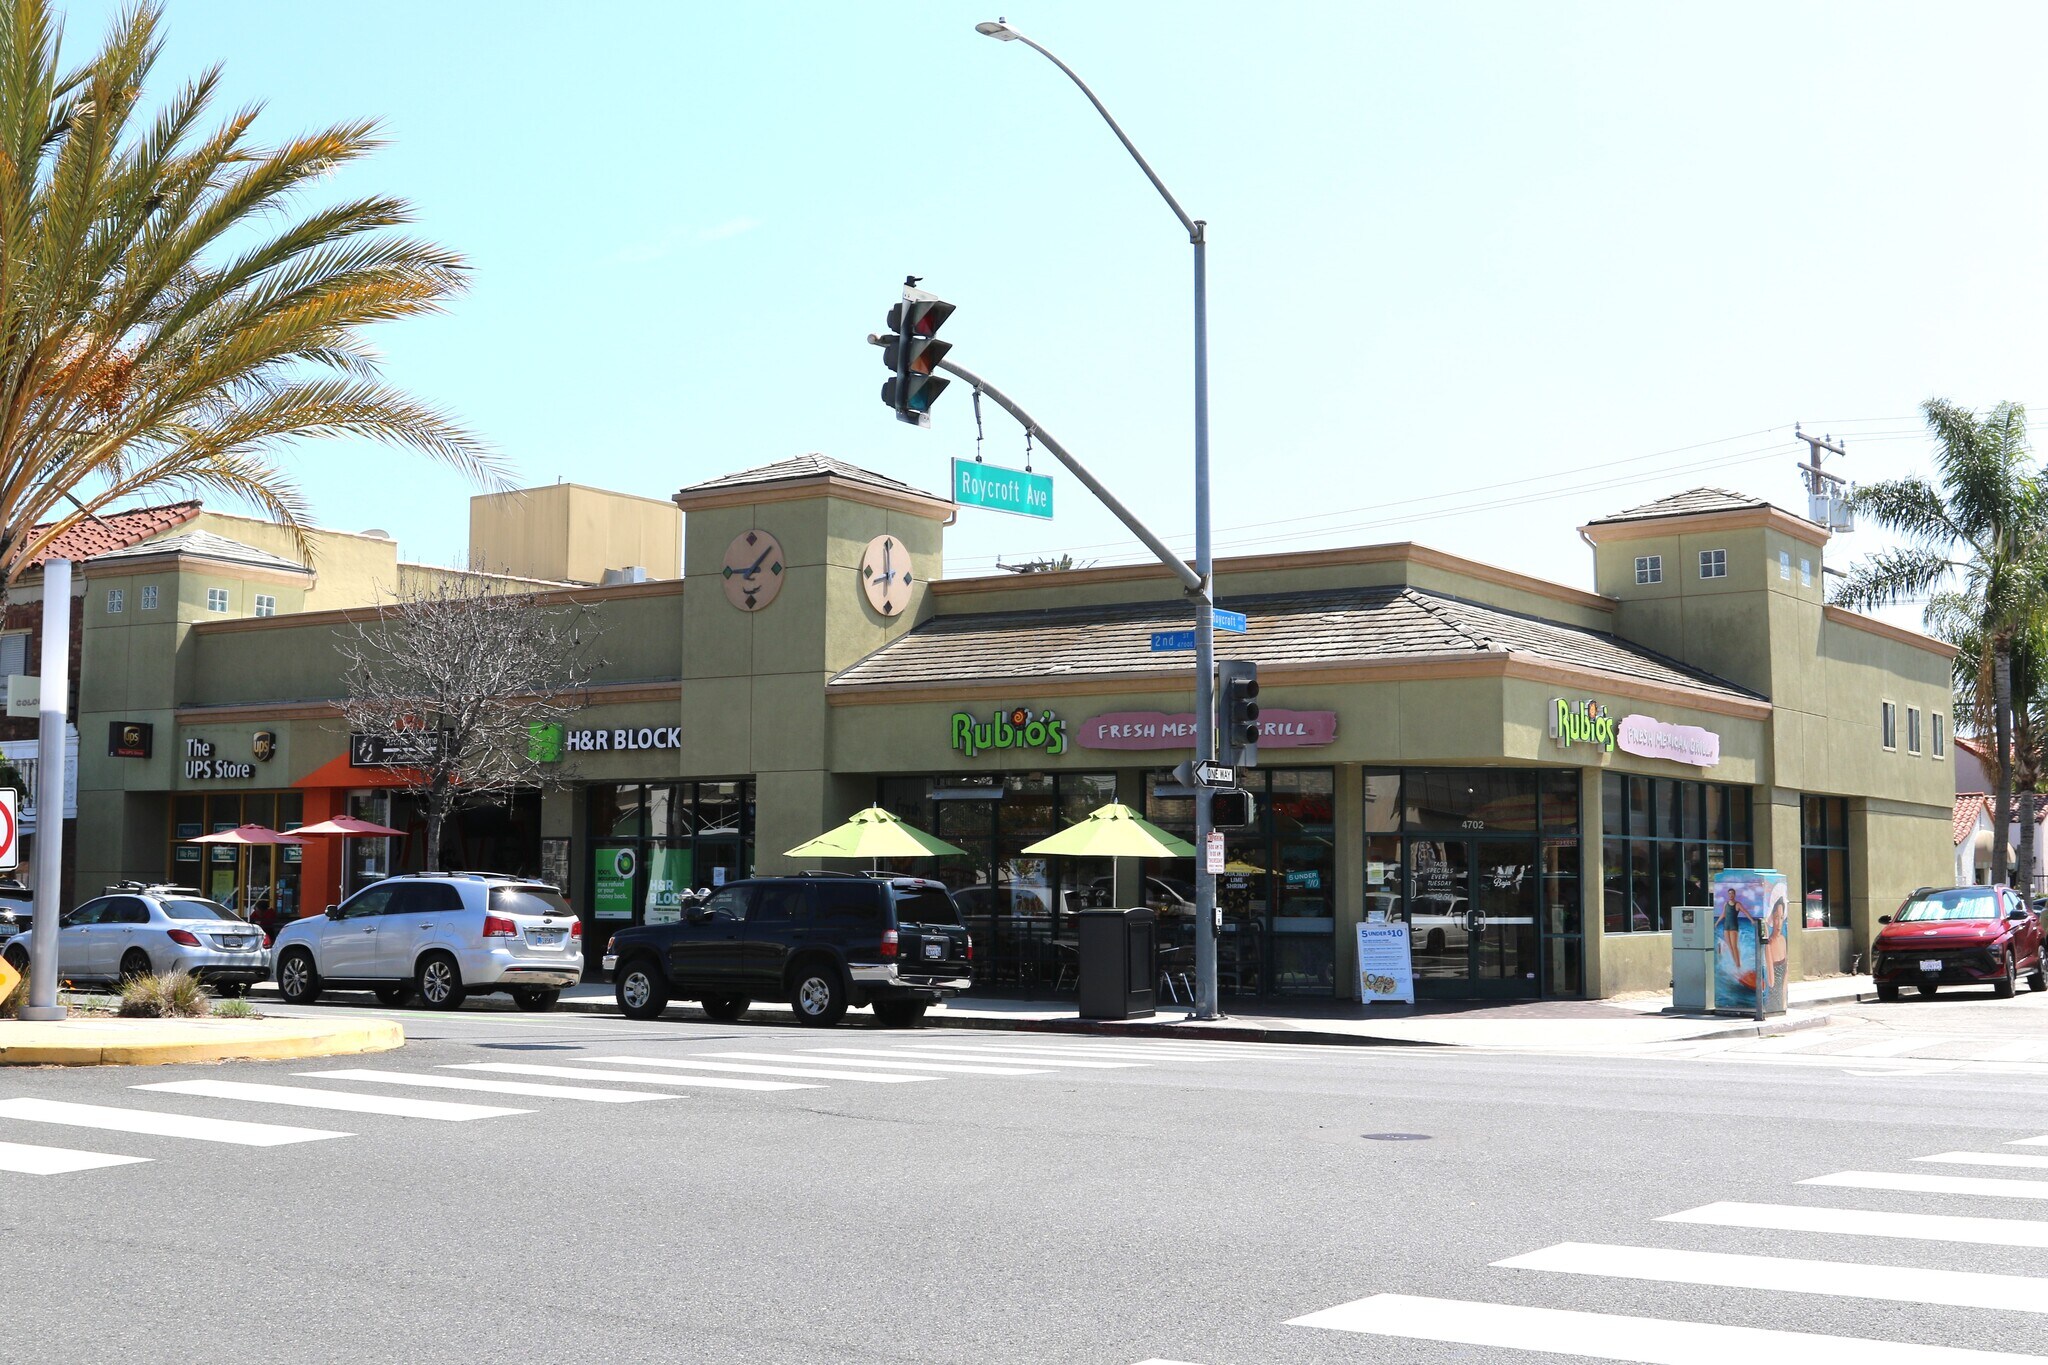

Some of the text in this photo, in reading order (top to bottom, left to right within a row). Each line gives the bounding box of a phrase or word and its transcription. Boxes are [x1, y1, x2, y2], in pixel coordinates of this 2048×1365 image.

[962, 471, 1047, 508] Roycroft Ave
[1155, 635, 1174, 647] 2nd
[952, 707, 1064, 757] Rubio's
[1098, 723, 1154, 739] FRESH
[1557, 699, 1614, 752] Rubio's
[126, 732, 140, 745] ups
[567, 727, 681, 751] H&R BLOCK
[1627, 726, 1652, 747] FRESH
[1654, 730, 1686, 753] MEXICAN
[186, 738, 210, 757] The
[254, 740, 269, 757] ups
[185, 760, 250, 779] UPS Store
[1207, 768, 1232, 780] ONE WAY
[1461, 821, 1484, 829] 4702
[650, 880, 673, 890] H&R
[1493, 878, 1511, 888] Baja
[650, 893, 680, 903] BLOC
[1387, 929, 1403, 937] $10
